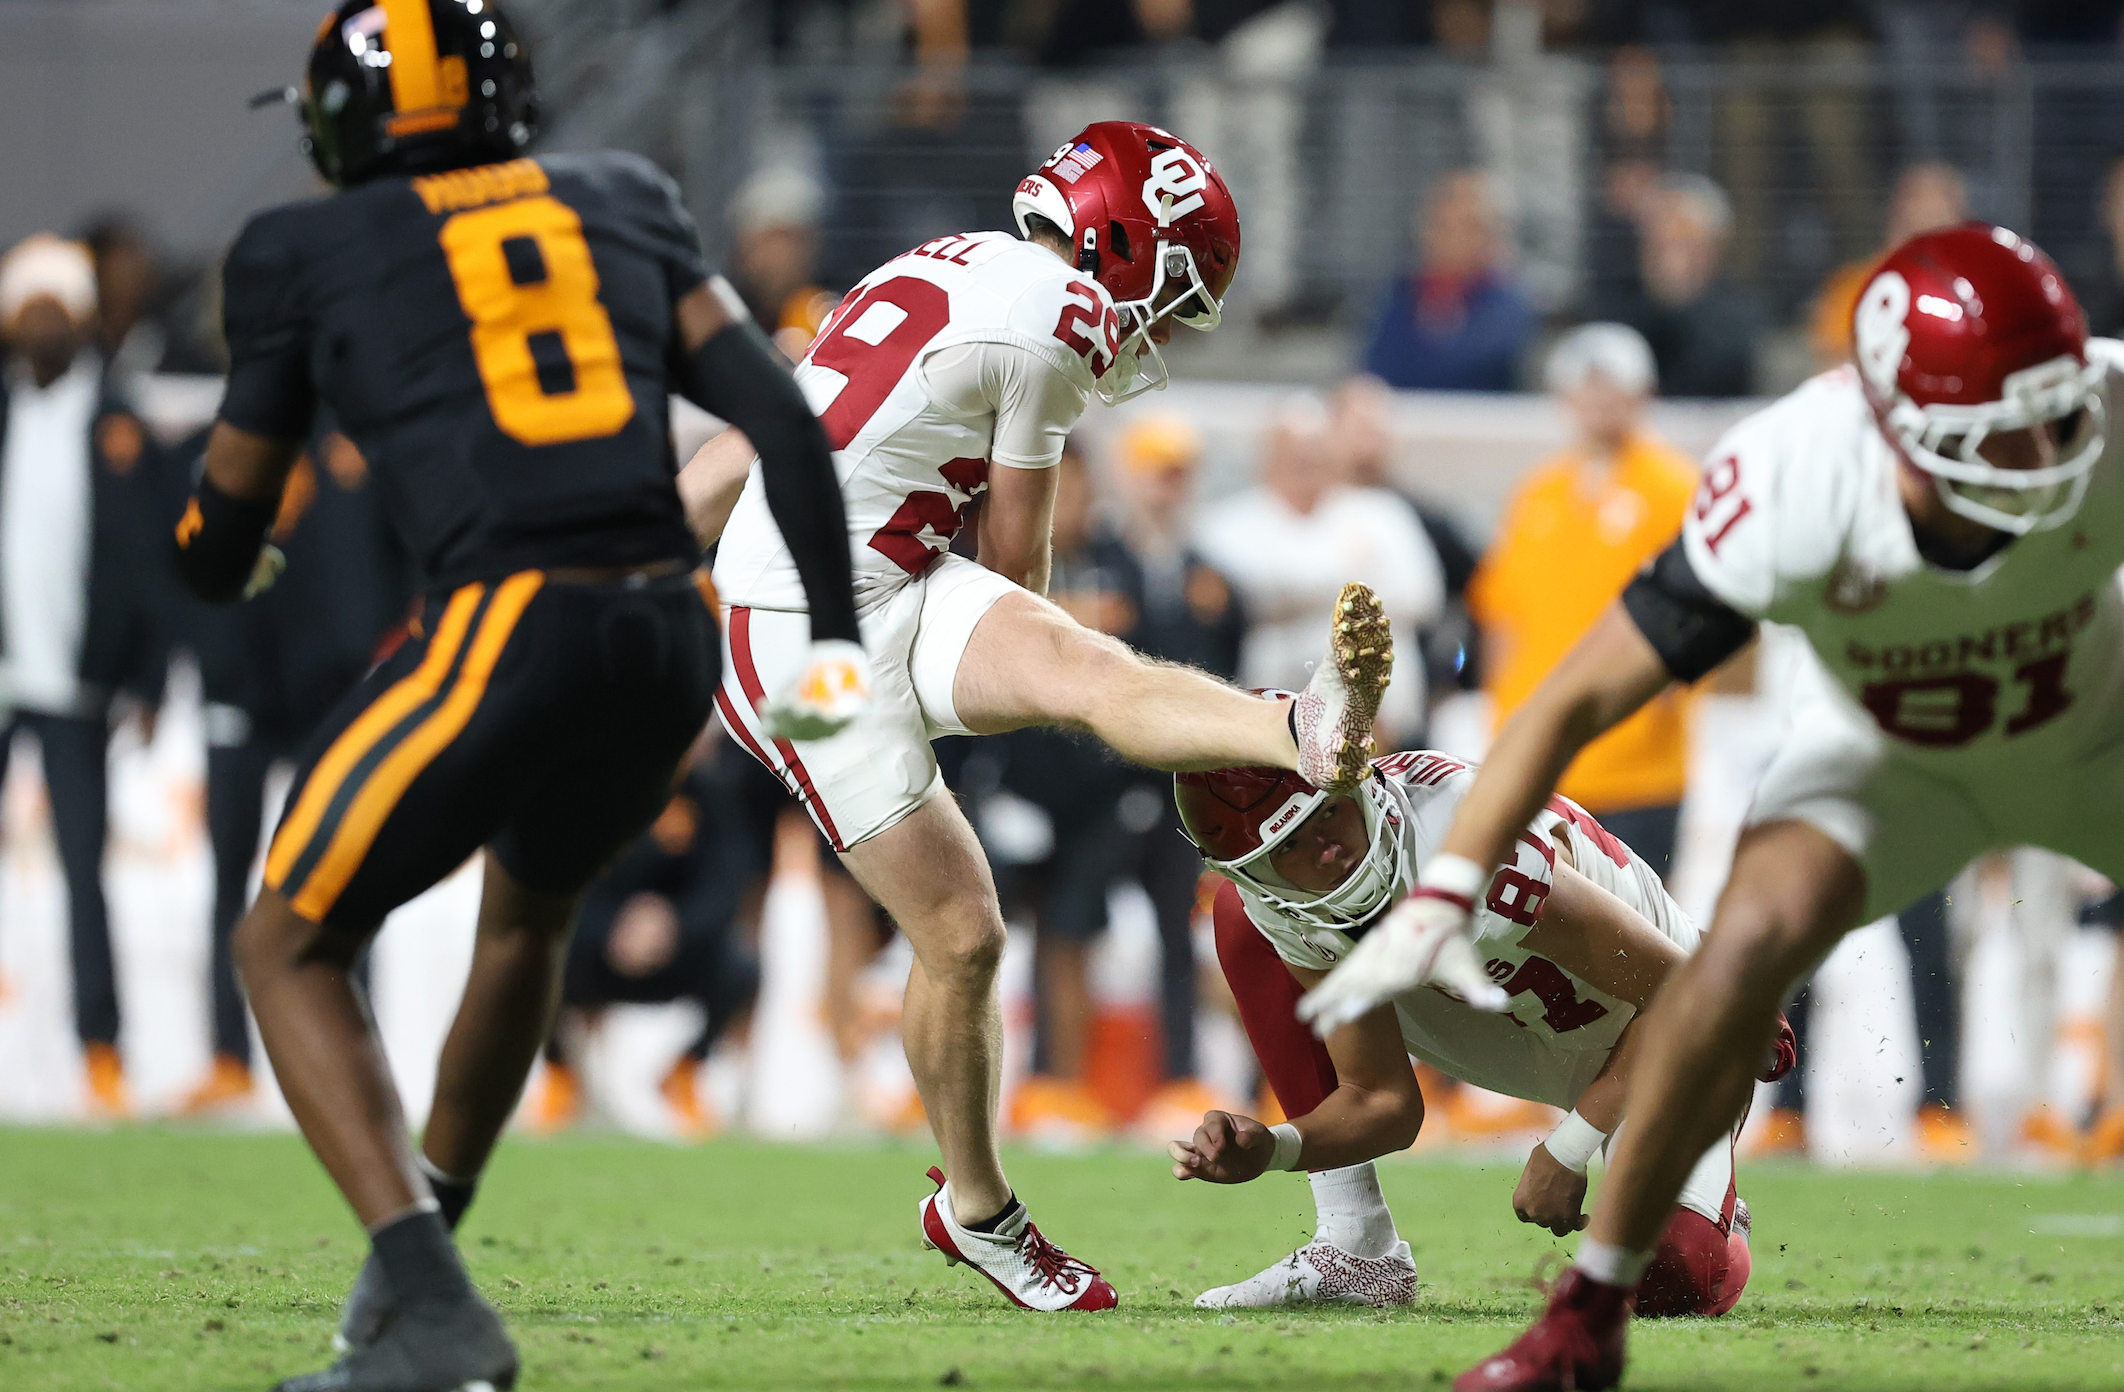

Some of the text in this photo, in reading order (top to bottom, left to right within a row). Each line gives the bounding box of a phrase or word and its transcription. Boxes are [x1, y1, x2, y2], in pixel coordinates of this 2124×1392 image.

[1043, 142, 1075, 168] 9
[438, 196, 636, 447] 8
[1052, 280, 1121, 379] 29
[1696, 455, 1752, 558] 81
[1847, 591, 2097, 671] SOONERS
[1862, 652, 2077, 748] 81
[1269, 804, 1301, 834] OKLAHOMA
